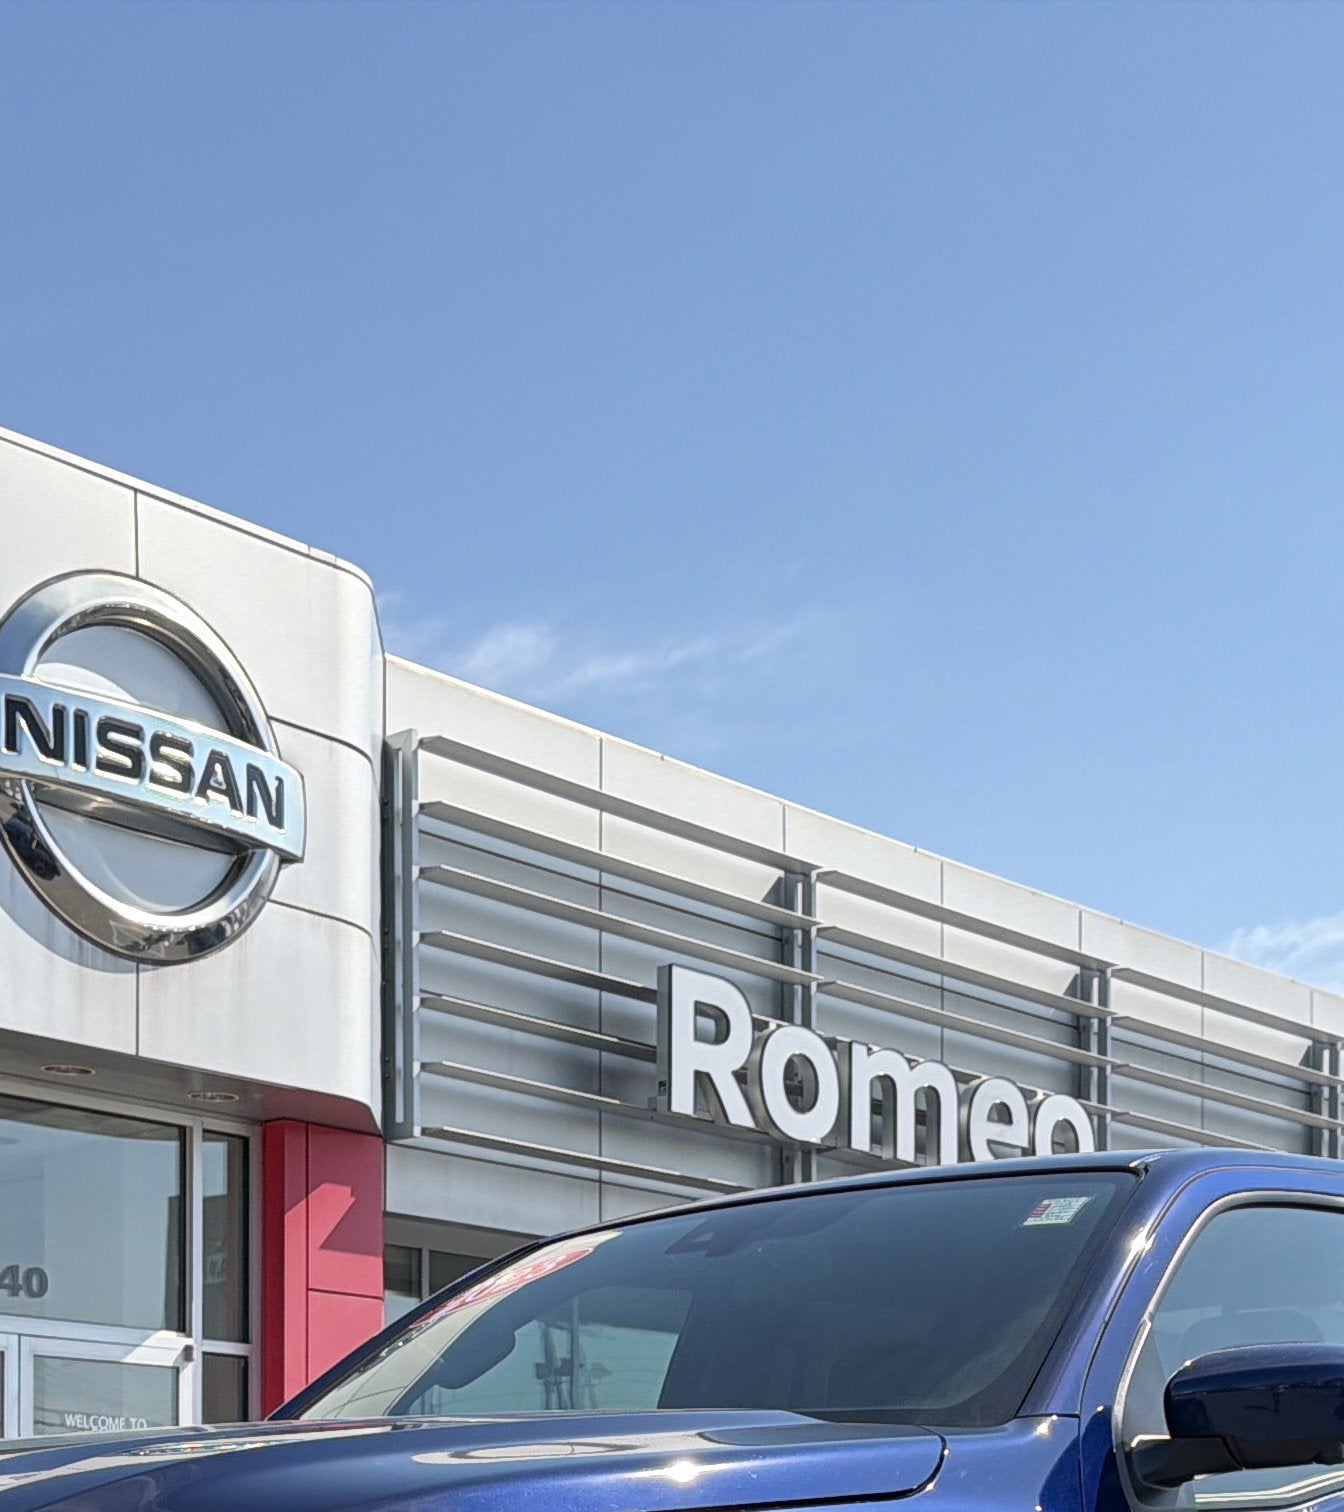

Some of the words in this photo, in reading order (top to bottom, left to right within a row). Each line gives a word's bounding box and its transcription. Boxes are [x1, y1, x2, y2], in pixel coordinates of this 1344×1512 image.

[0, 694, 287, 835] NISSAN
[660, 963, 1096, 1165] Romeo
[64, 1412, 127, 1431] WELCOME
[129, 1417, 148, 1430] TO
